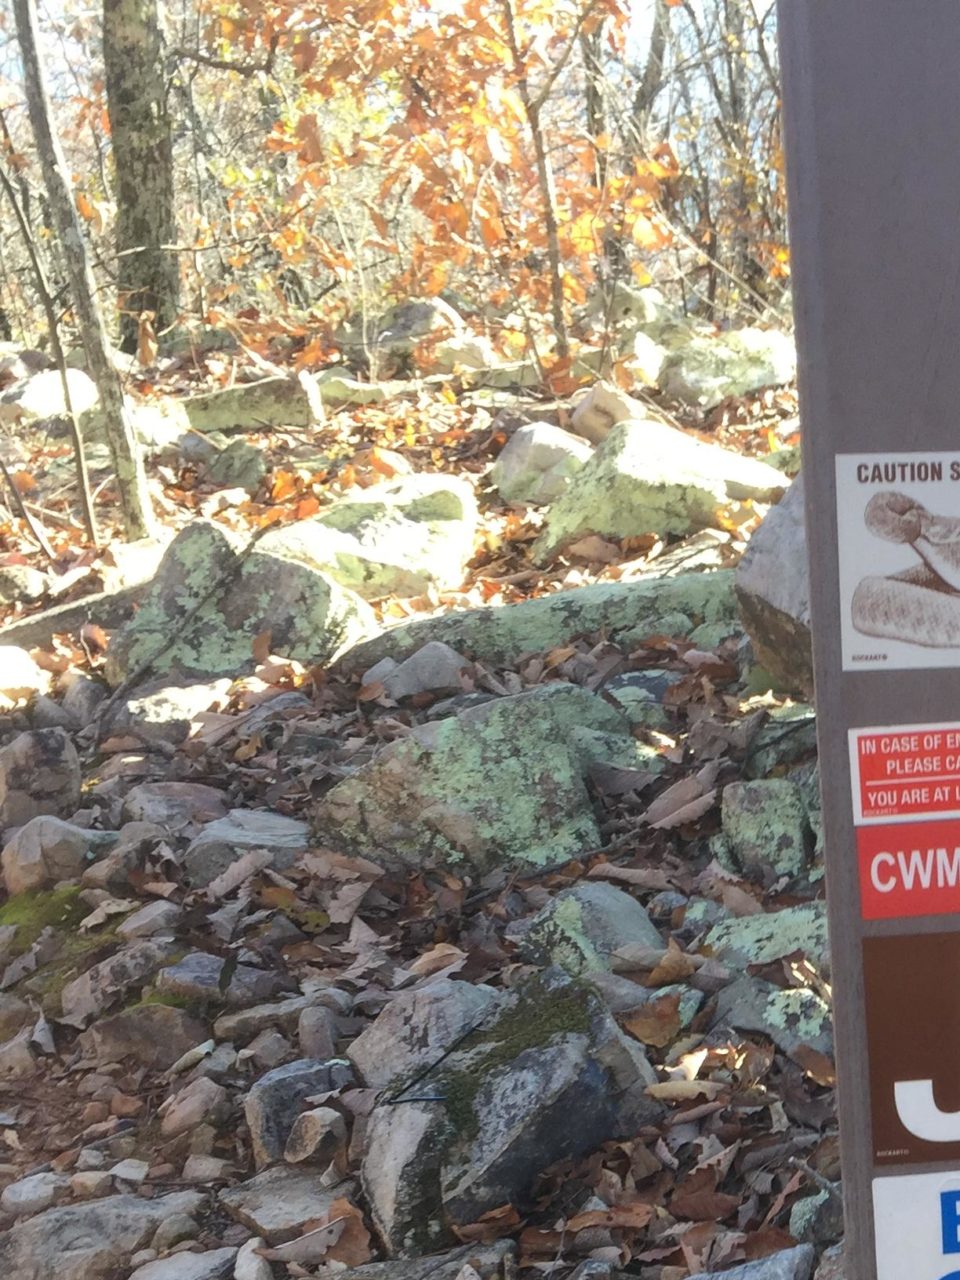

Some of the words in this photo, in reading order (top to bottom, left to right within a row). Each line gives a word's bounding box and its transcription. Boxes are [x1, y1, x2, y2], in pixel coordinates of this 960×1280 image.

[857, 461, 943, 483] CAUTION
[861, 739, 876, 755] IN
[881, 736, 919, 753] CASE
[923, 734, 942, 750] OF
[887, 756, 941, 775] PLEASE
[868, 790, 897, 807] YOU
[901, 787, 930, 804] ARE
[933, 786, 950, 802] AT
